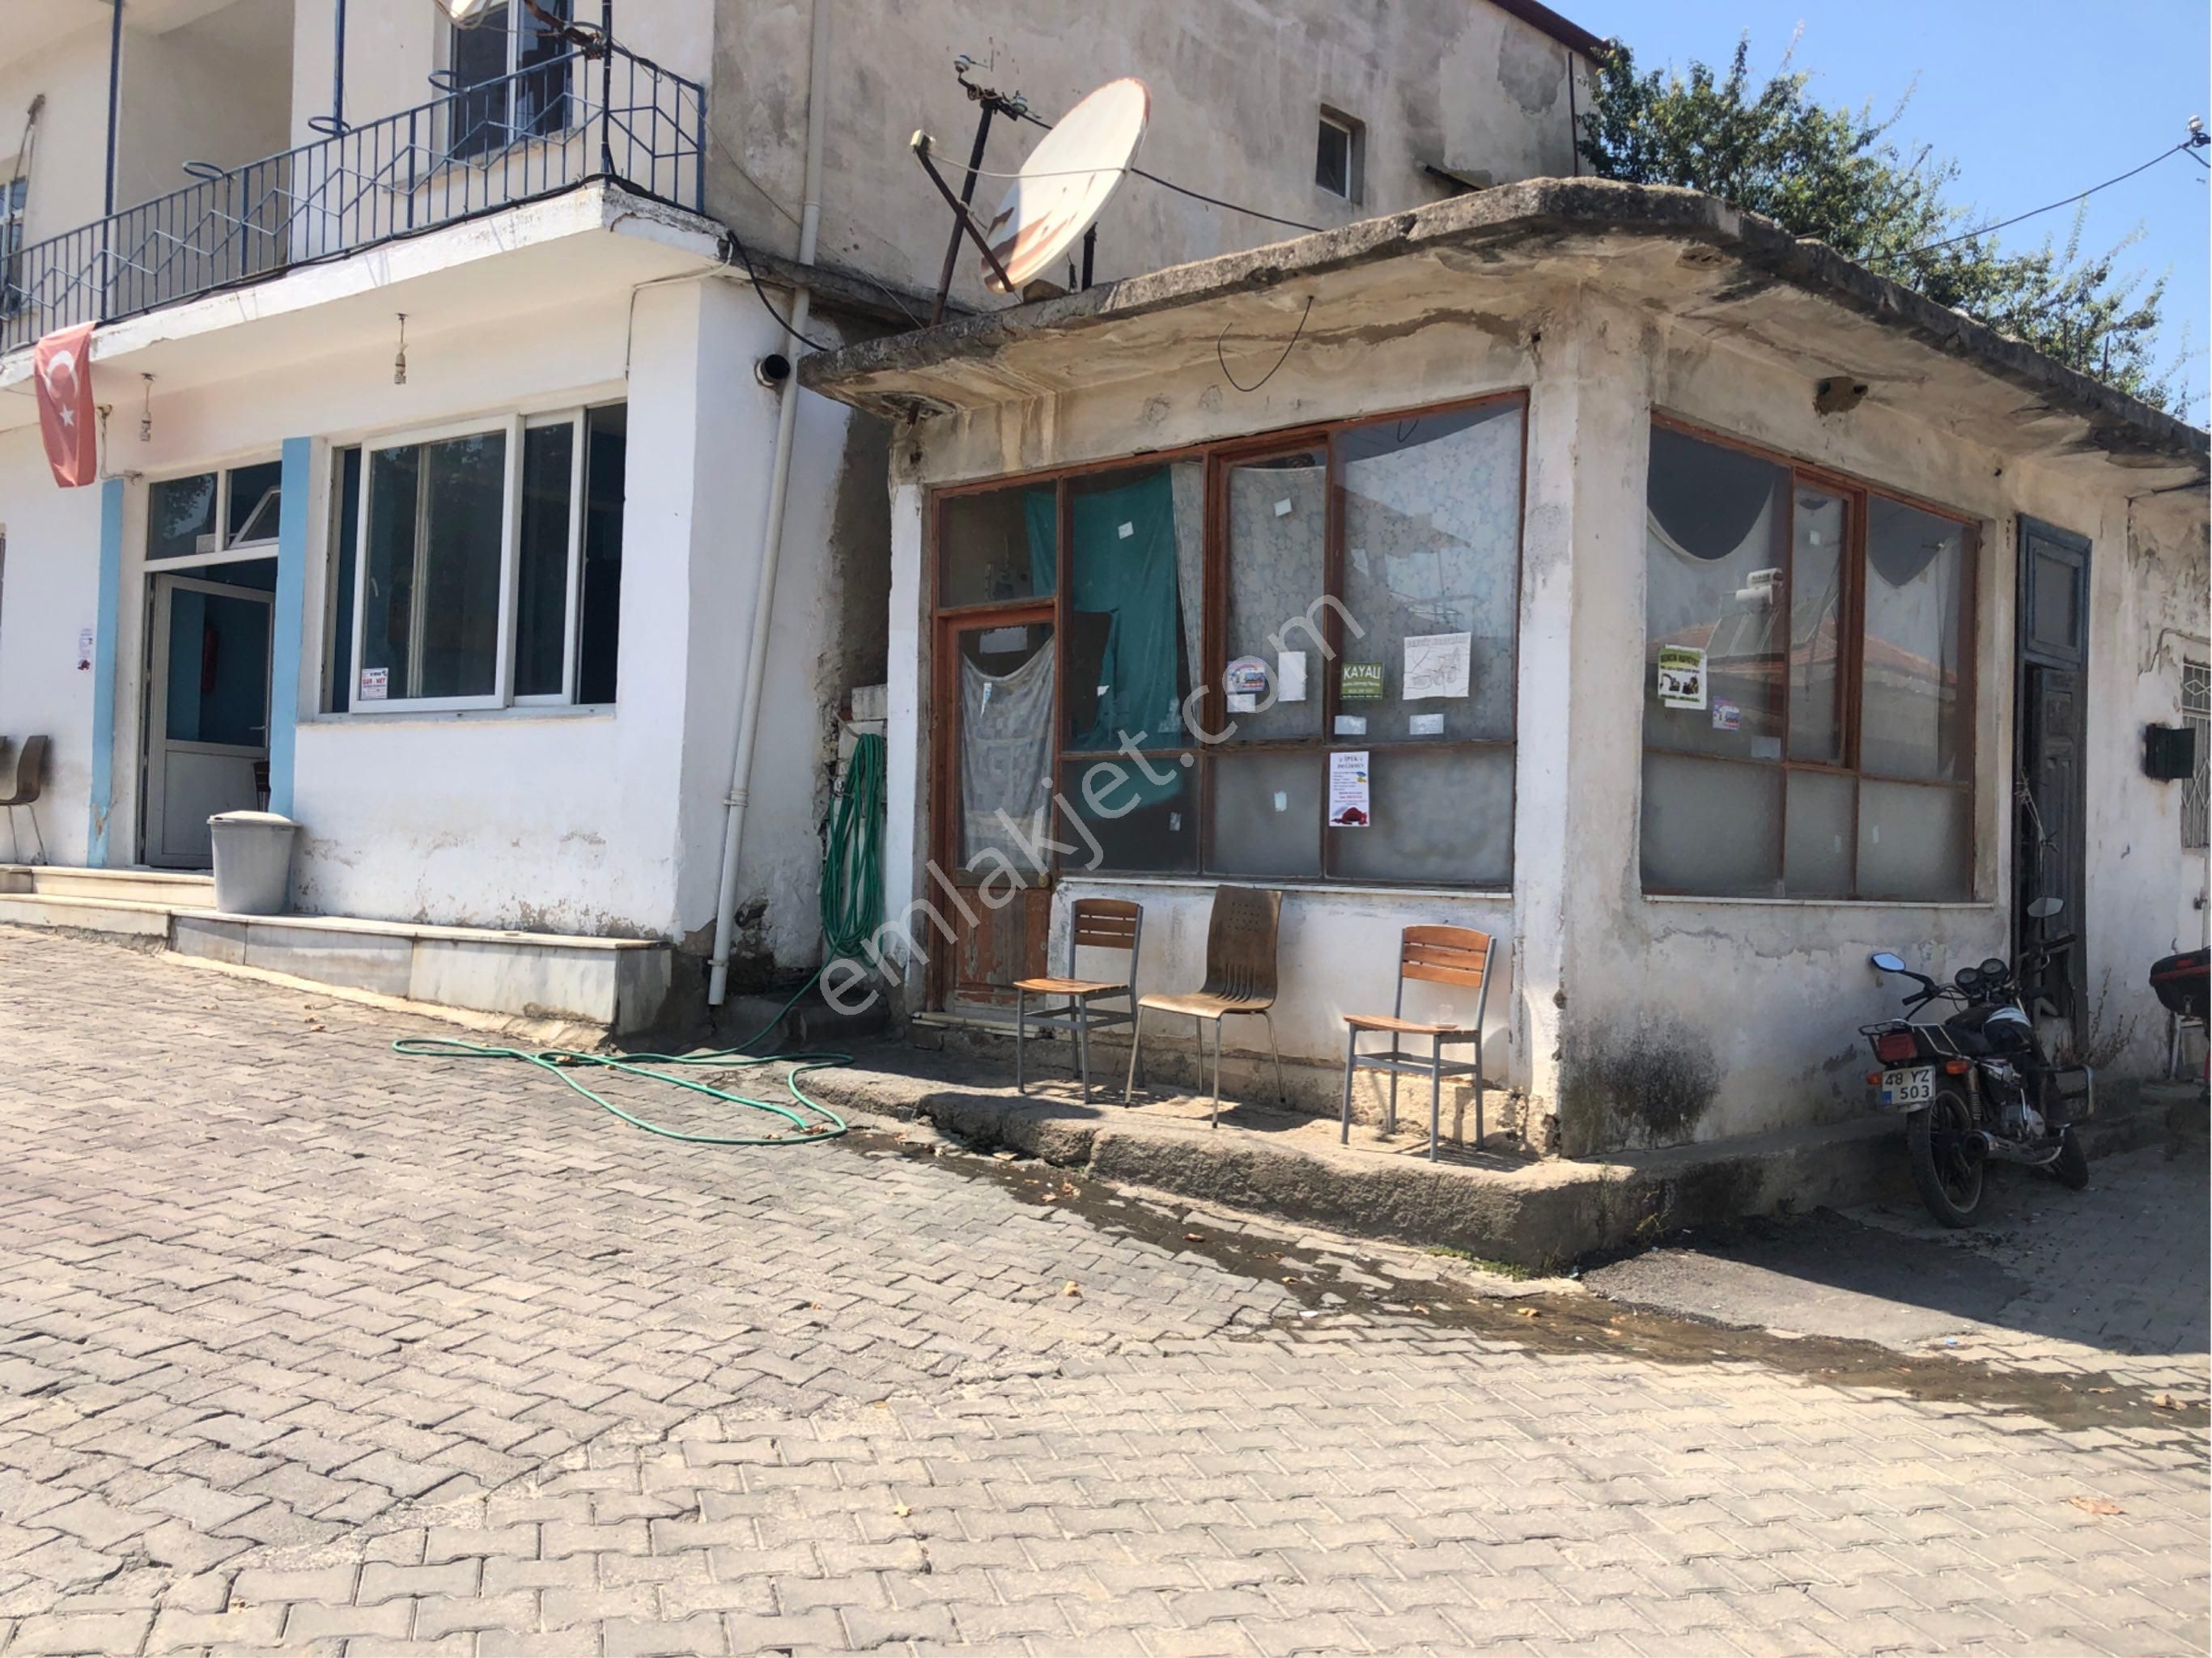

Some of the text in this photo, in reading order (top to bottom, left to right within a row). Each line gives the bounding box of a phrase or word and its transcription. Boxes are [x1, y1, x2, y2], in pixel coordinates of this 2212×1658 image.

[1344, 665, 1382, 680] KAYALI
[1885, 1069, 1930, 1085] 48 YZ
[1900, 1085, 1930, 1100] 503
